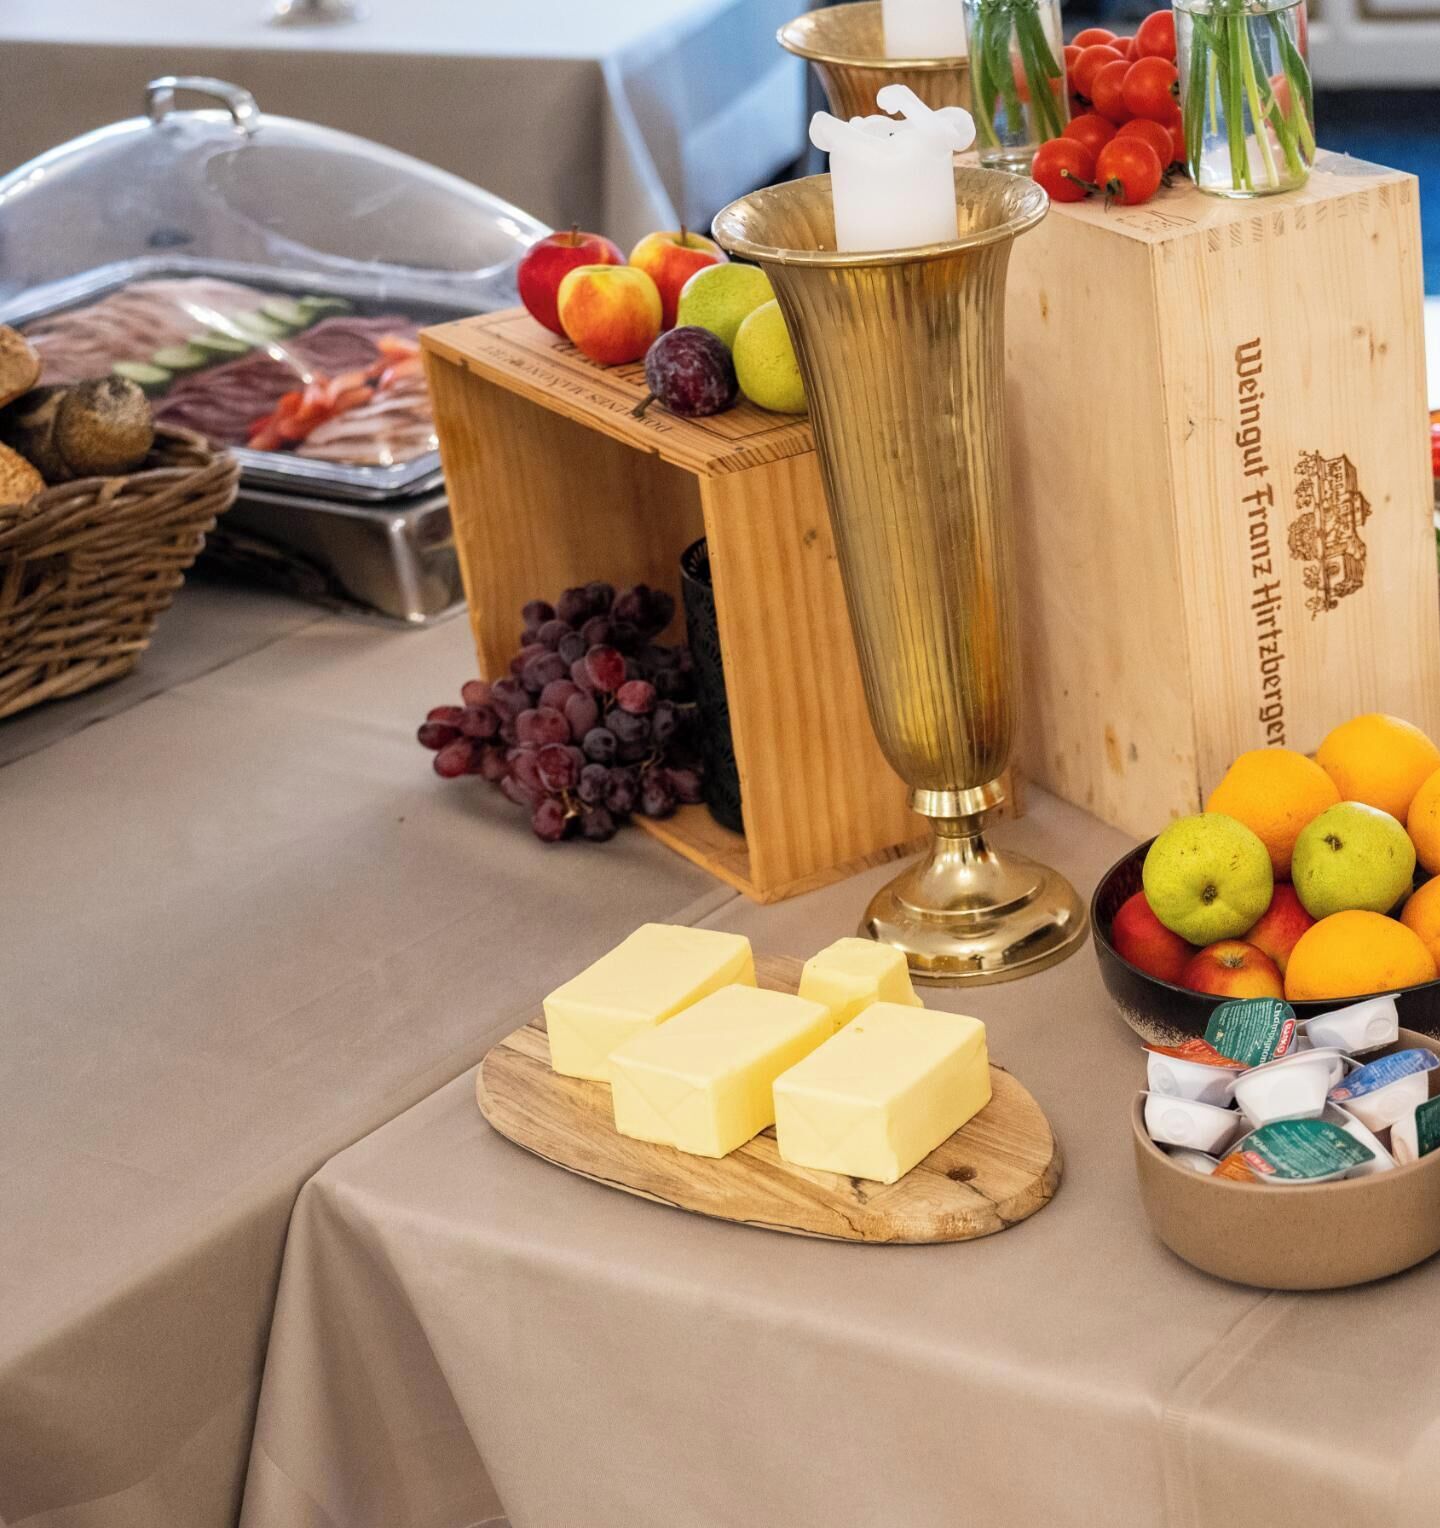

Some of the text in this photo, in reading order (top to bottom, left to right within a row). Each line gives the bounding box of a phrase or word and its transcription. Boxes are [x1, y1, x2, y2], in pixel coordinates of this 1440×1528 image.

[1234, 337, 1286, 746] Weingut Franz Hirtzberger
